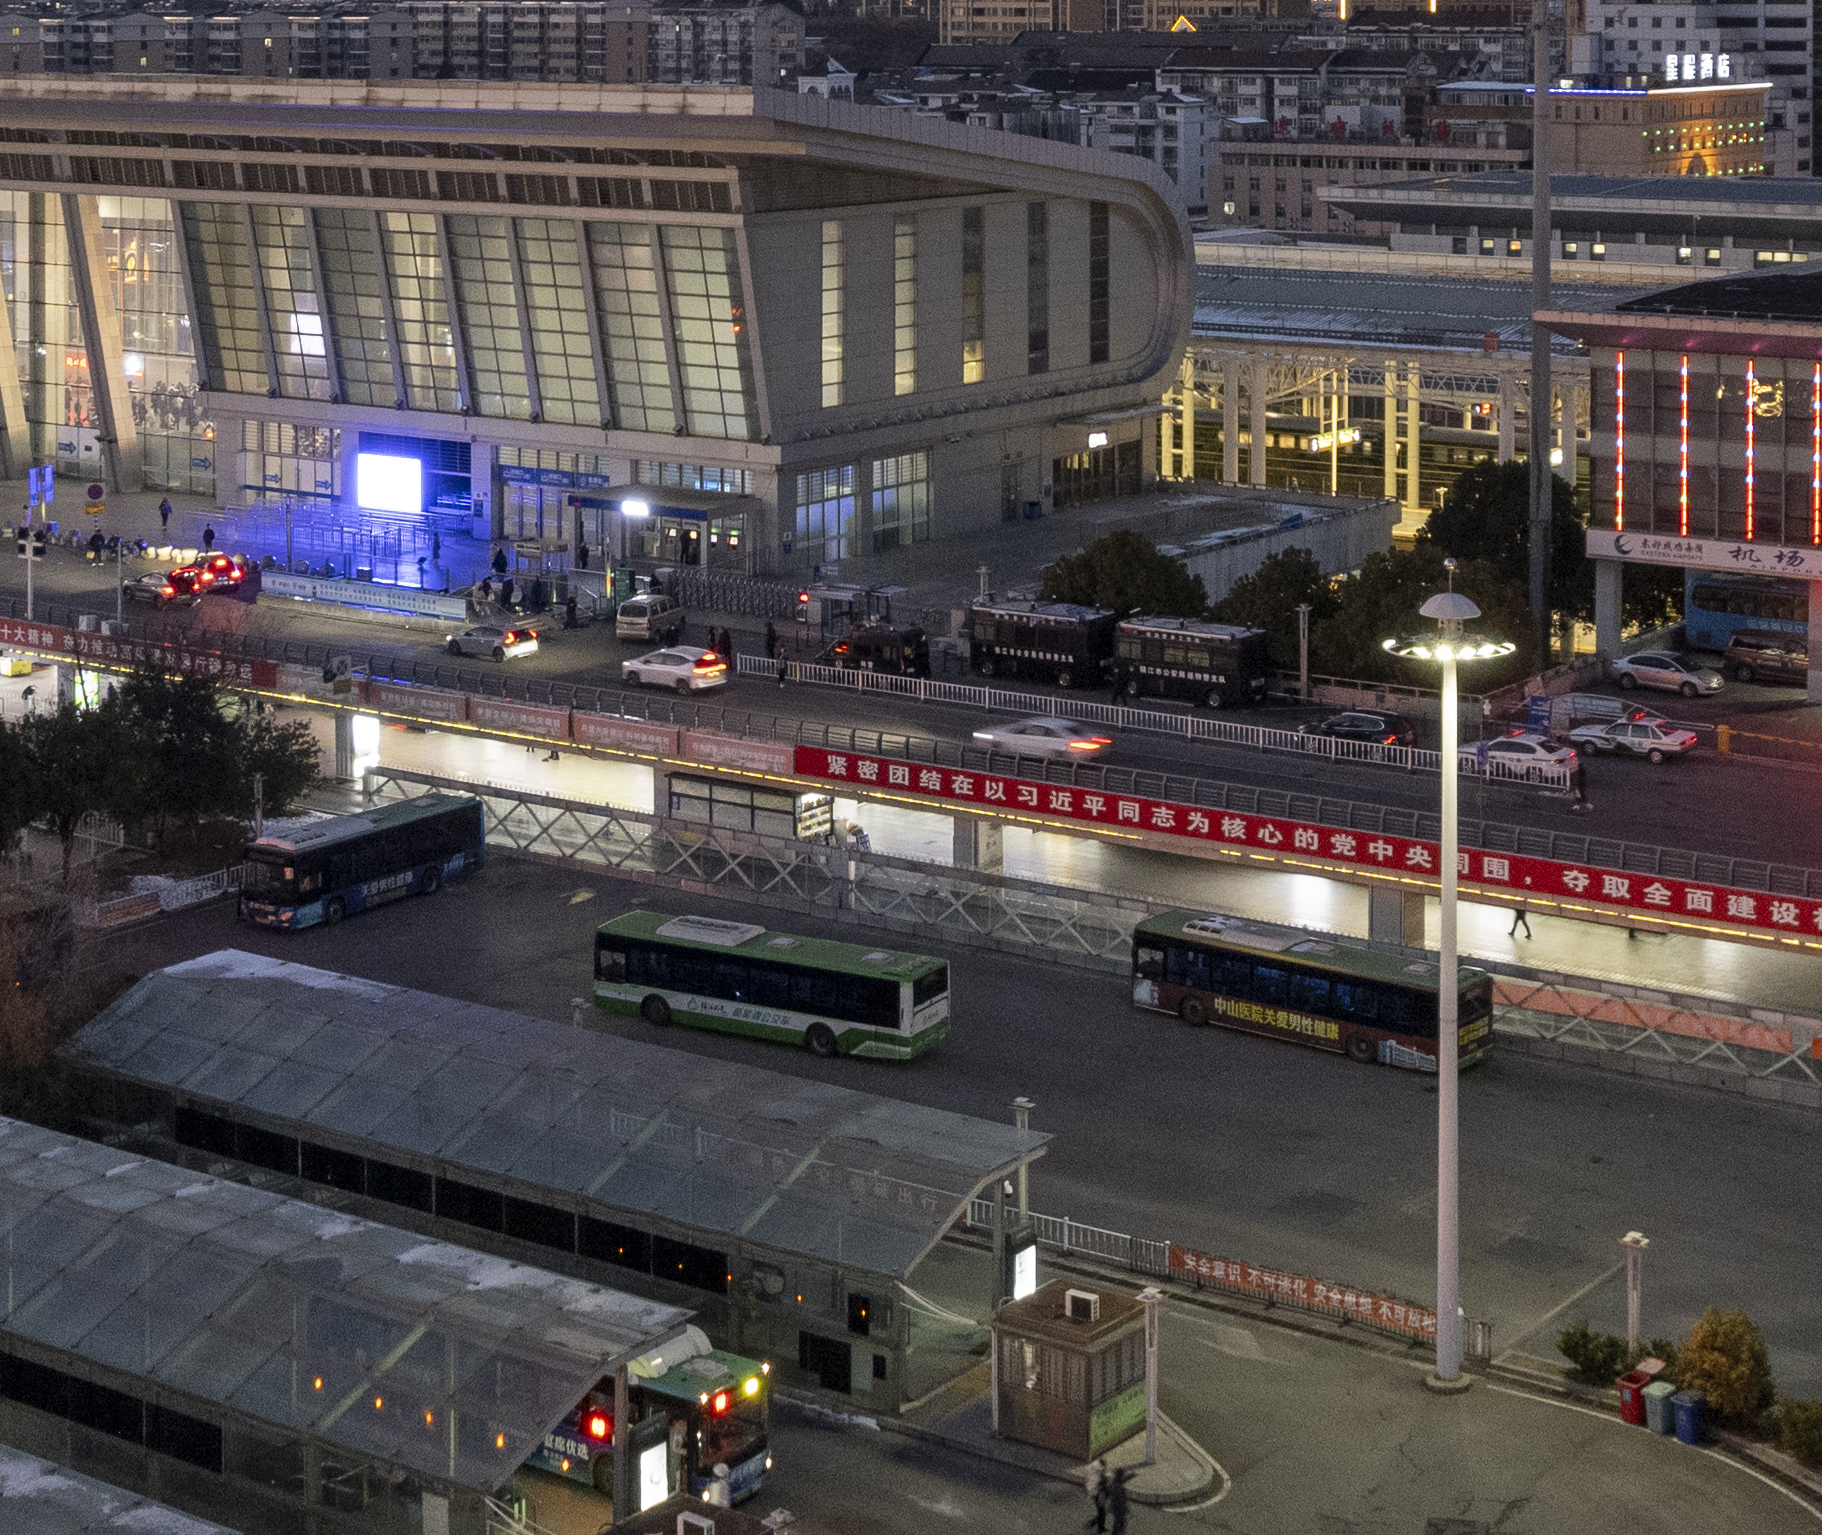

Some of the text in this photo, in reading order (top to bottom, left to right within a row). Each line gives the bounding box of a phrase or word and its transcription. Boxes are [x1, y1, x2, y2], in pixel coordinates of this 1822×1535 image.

[1214, 997, 1339, 1040] 中山医院关爱男性健康
[1183, 1253, 1242, 1283] 安全意识
